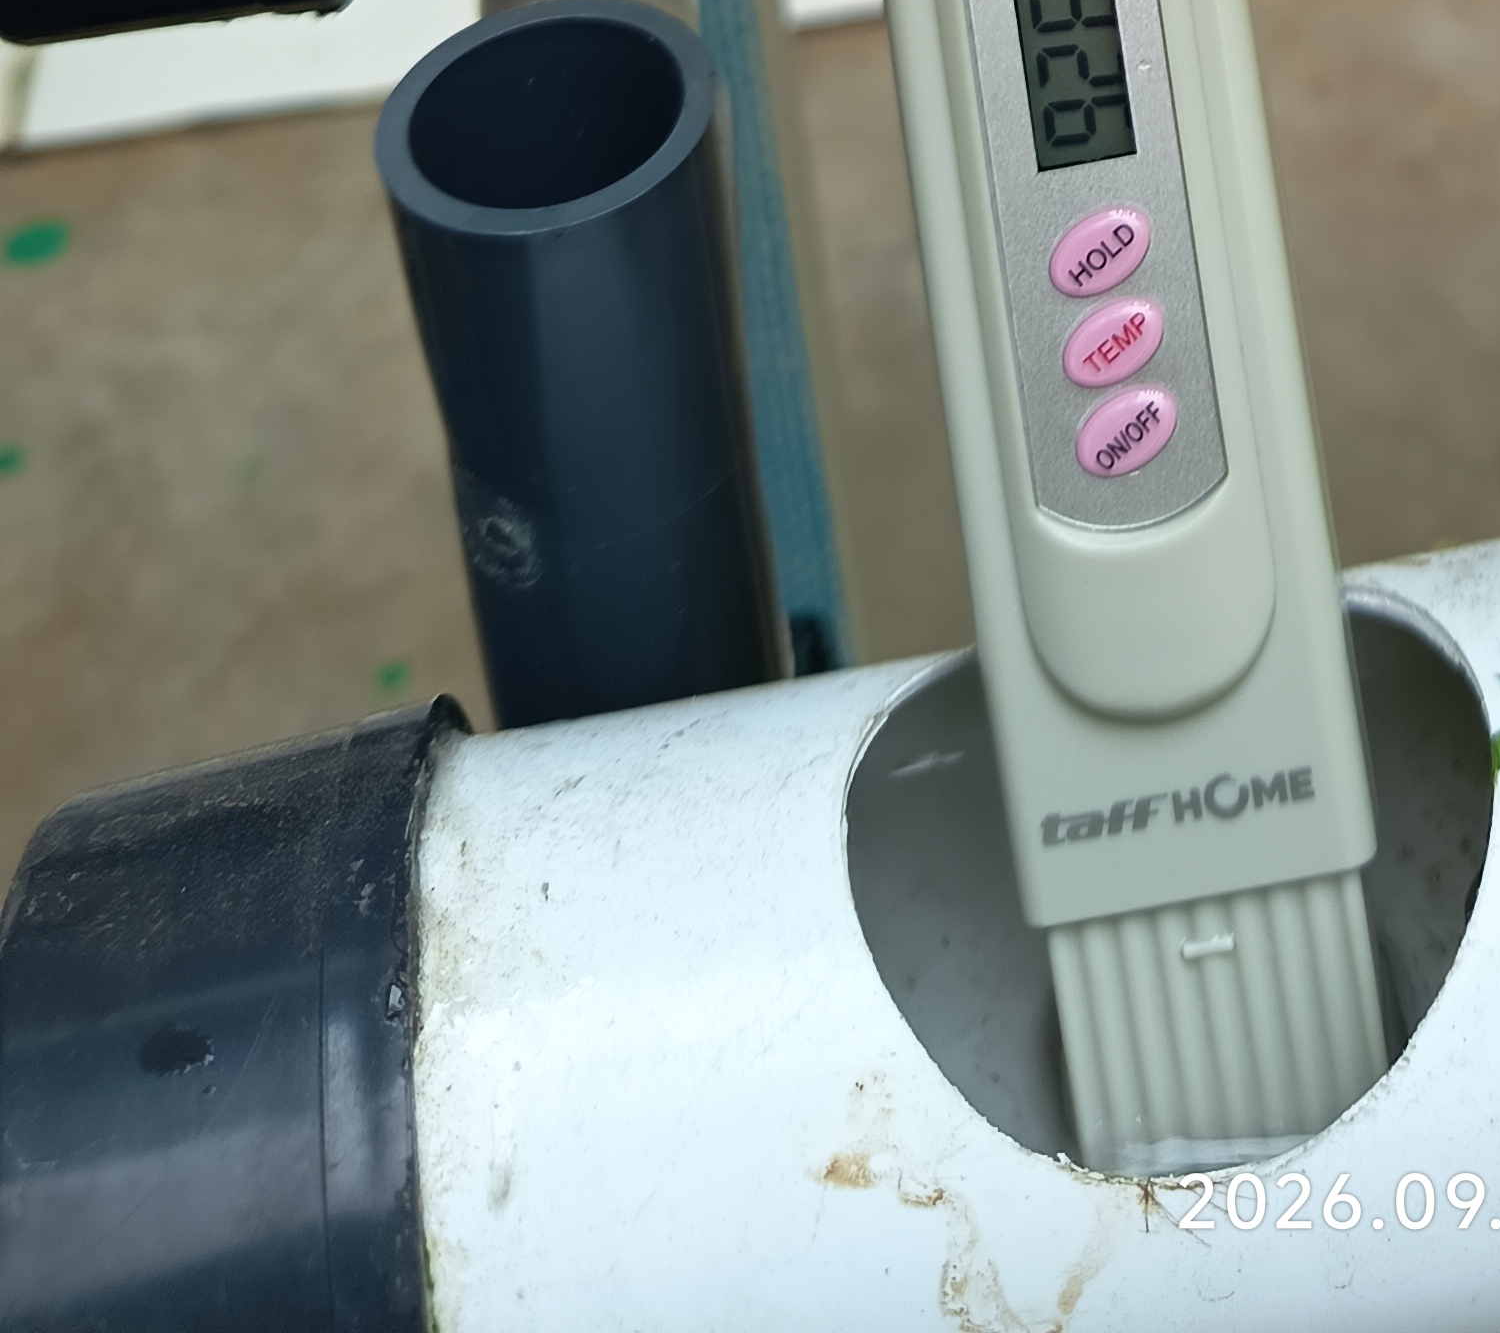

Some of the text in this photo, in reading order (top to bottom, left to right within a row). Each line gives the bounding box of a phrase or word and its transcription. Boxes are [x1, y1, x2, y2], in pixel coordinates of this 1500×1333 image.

[1069, 223, 1135, 287] HOLD
[1083, 312, 1148, 373] TEMP
[1095, 401, 1161, 470] ON/OFF
